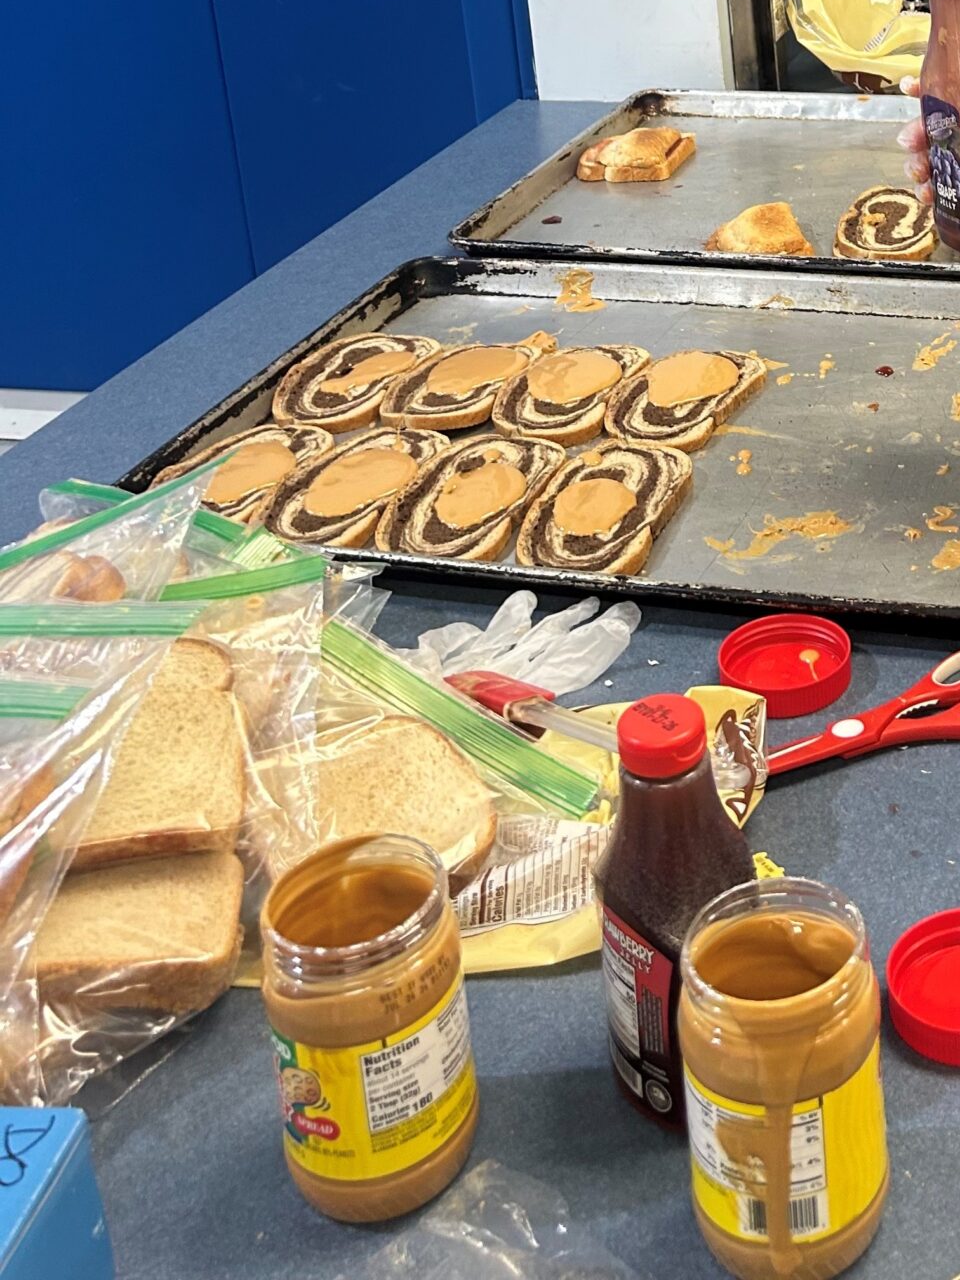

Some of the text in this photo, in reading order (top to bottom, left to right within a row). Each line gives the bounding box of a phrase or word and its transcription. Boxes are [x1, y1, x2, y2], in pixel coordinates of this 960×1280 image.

[936, 180, 958, 203] GRAPE
[939, 197, 957, 211] JELLY
[491, 885, 504, 923] Calories
[363, 1036, 420, 1067] Nutrition
[365, 1057, 402, 1078] Facts
[368, 1088, 402, 1104] Serving
[371, 1104, 411, 1123] Calories
[412, 1091, 433, 1112] 180
